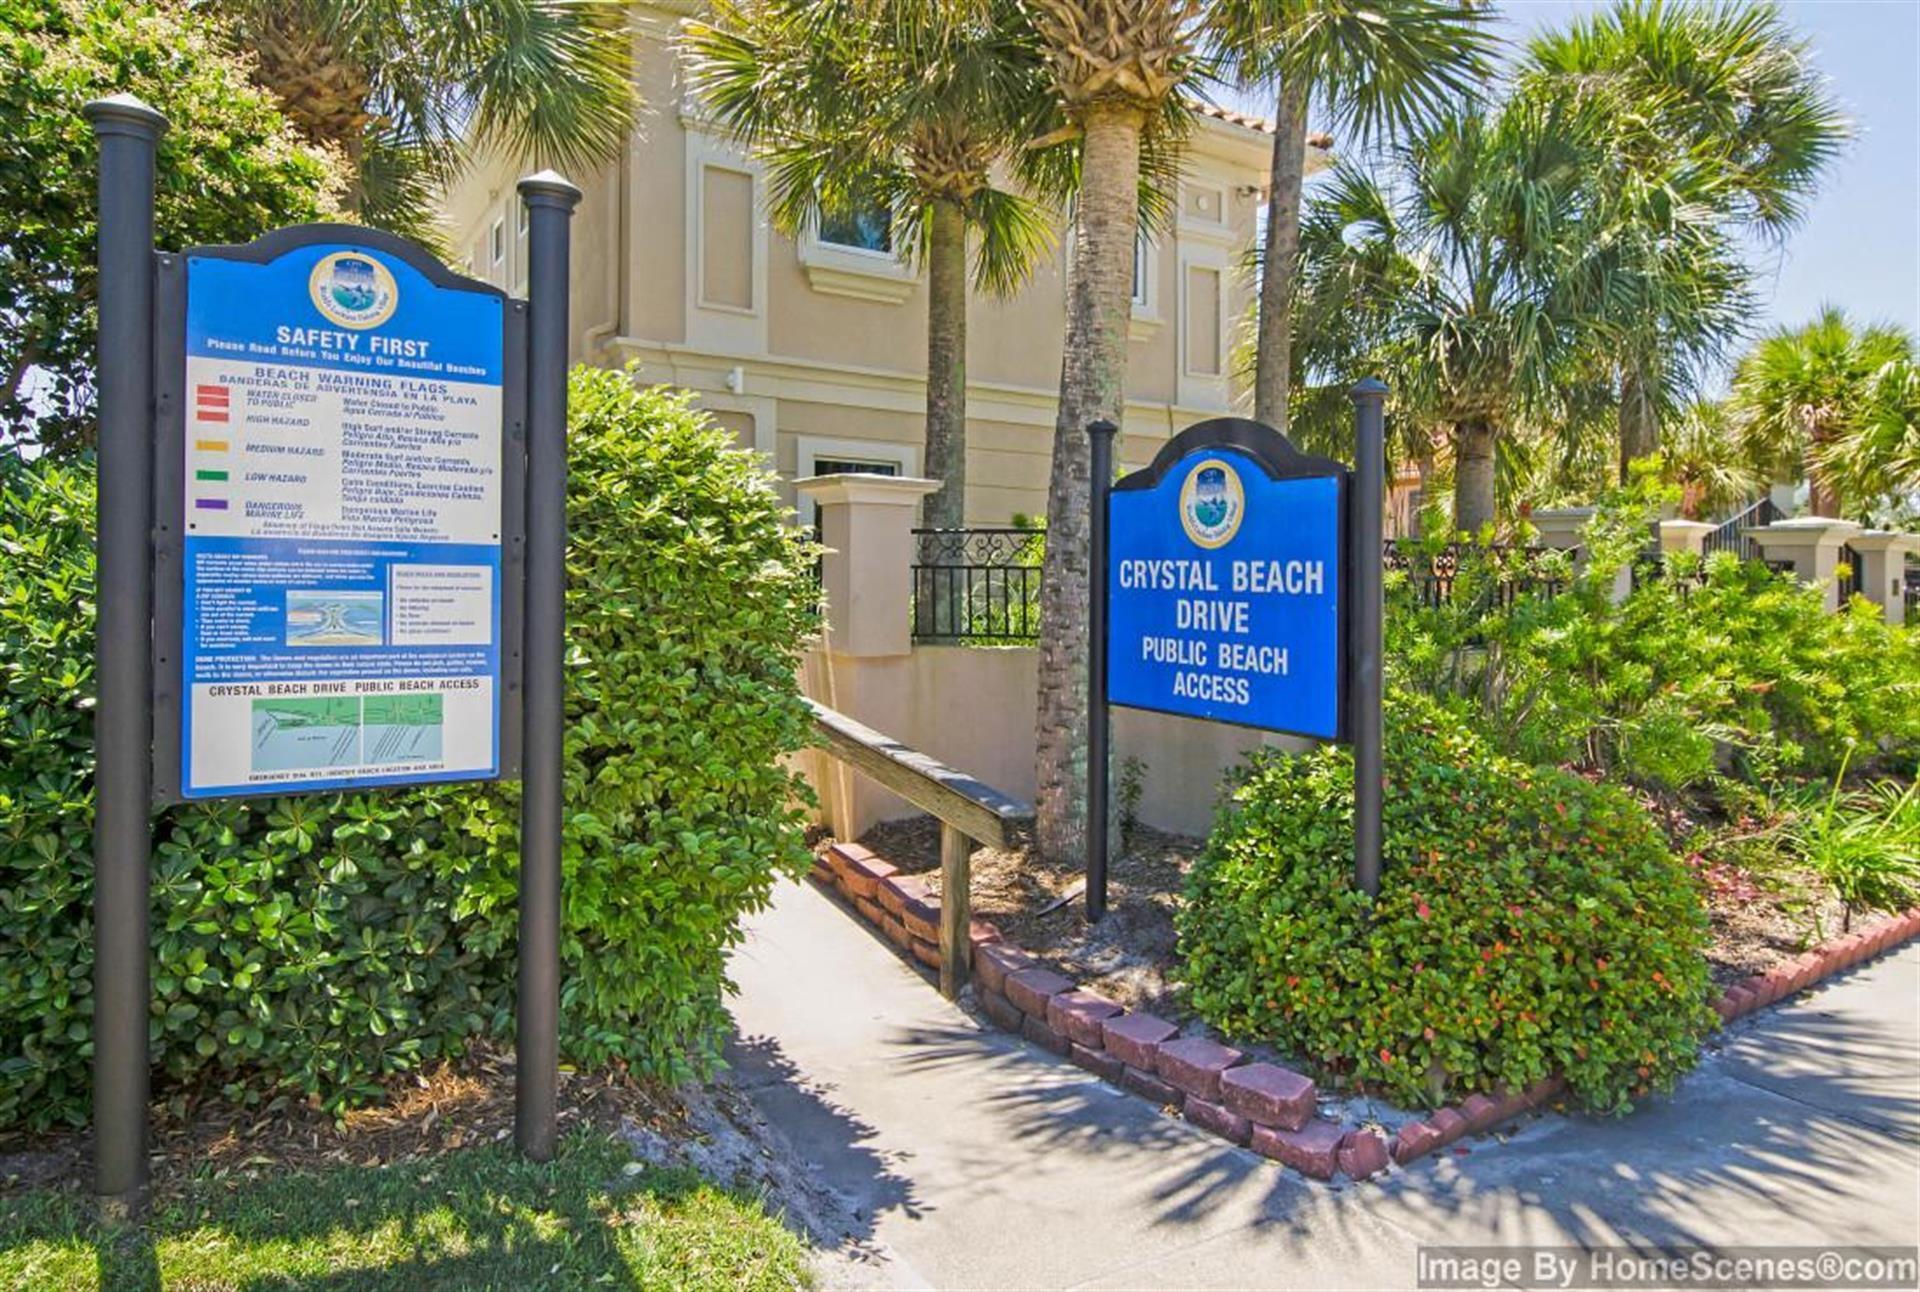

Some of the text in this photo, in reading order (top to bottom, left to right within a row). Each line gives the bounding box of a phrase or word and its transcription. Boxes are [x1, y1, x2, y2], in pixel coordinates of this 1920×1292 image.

[276, 325, 429, 358] SAFETY FIRST
[207, 338, 487, 376] Please Read Before You Enjoy Our Beautiful Beaches
[219, 374, 290, 389] BANDERAS
[294, 382, 310, 391] DE
[403, 392, 418, 400] EN
[424, 394, 438, 402] LA
[443, 395, 478, 406] PLAYA
[255, 367, 448, 394] BEACH WARNING FLAGS
[246, 415, 310, 427] HIGH HAZARD
[246, 443, 326, 457] MEDIUM HAZARD
[245, 472, 307, 484] LOW HAZARD
[245, 500, 302, 511] DANGEROUS
[245, 510, 281, 519] MARINE
[1119, 560, 1324, 595] CRYSTAL BEACH
[1176, 599, 1250, 634] DRIVE
[1142, 636, 1289, 675] PUBLIC BEACH
[209, 678, 479, 697] CRYSTAL BEACH DRIVE PUBLIC BEACH ACCESS
[1173, 671, 1250, 705] ACCESS
